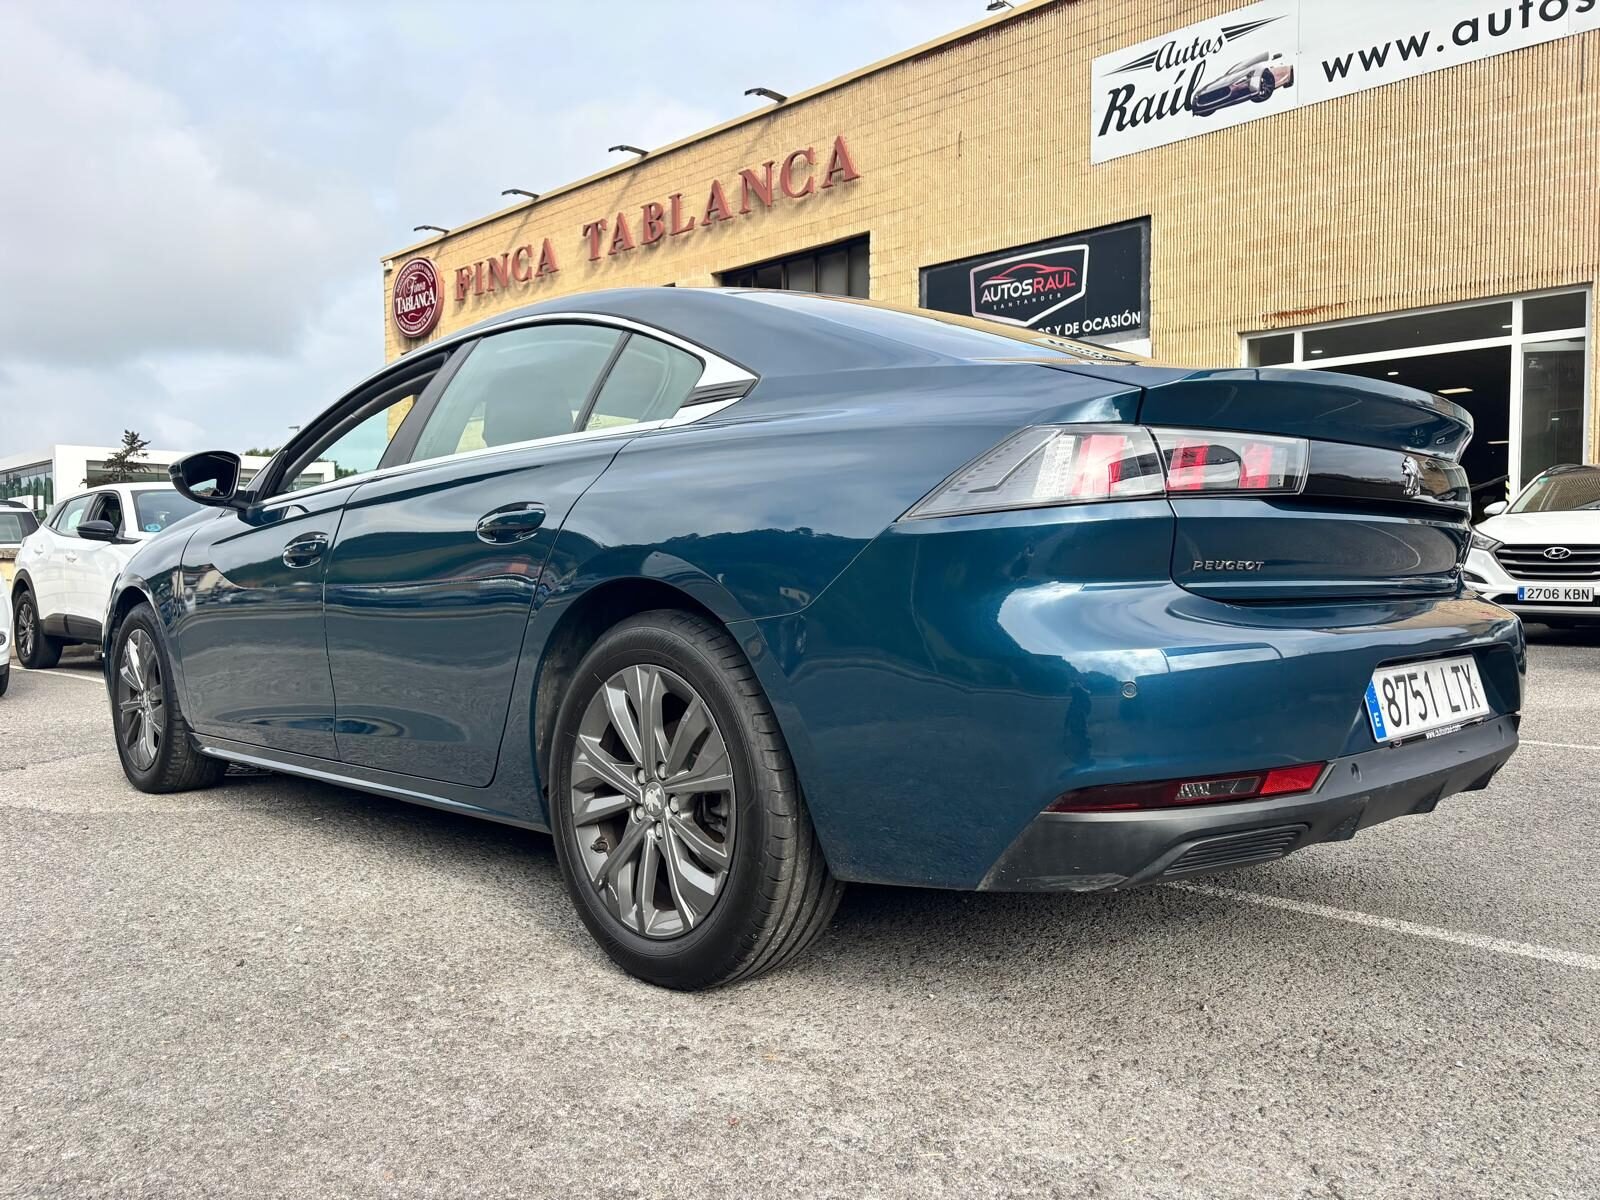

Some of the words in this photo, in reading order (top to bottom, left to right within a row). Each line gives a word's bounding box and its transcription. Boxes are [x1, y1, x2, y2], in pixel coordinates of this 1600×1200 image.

[1155, 36, 1223, 72] Autos
[1098, 60, 1206, 137] Raúl
[454, 237, 559, 301] FINCA
[582, 134, 861, 262] TABLANCA
[396, 287, 437, 315] TABLANCA
[993, 292, 1061, 311] SANTANDER
[1054, 324, 1062, 336] Y
[1064, 321, 1080, 336] DE
[1082, 310, 1141, 333] OCASIÓN
[1192, 560, 1265, 571] PEUGEOT
[1527, 588, 1560, 600] 2706
[1564, 588, 1590, 601] KBN
[1382, 670, 1439, 728] 8751
[1373, 712, 1382, 727] E
